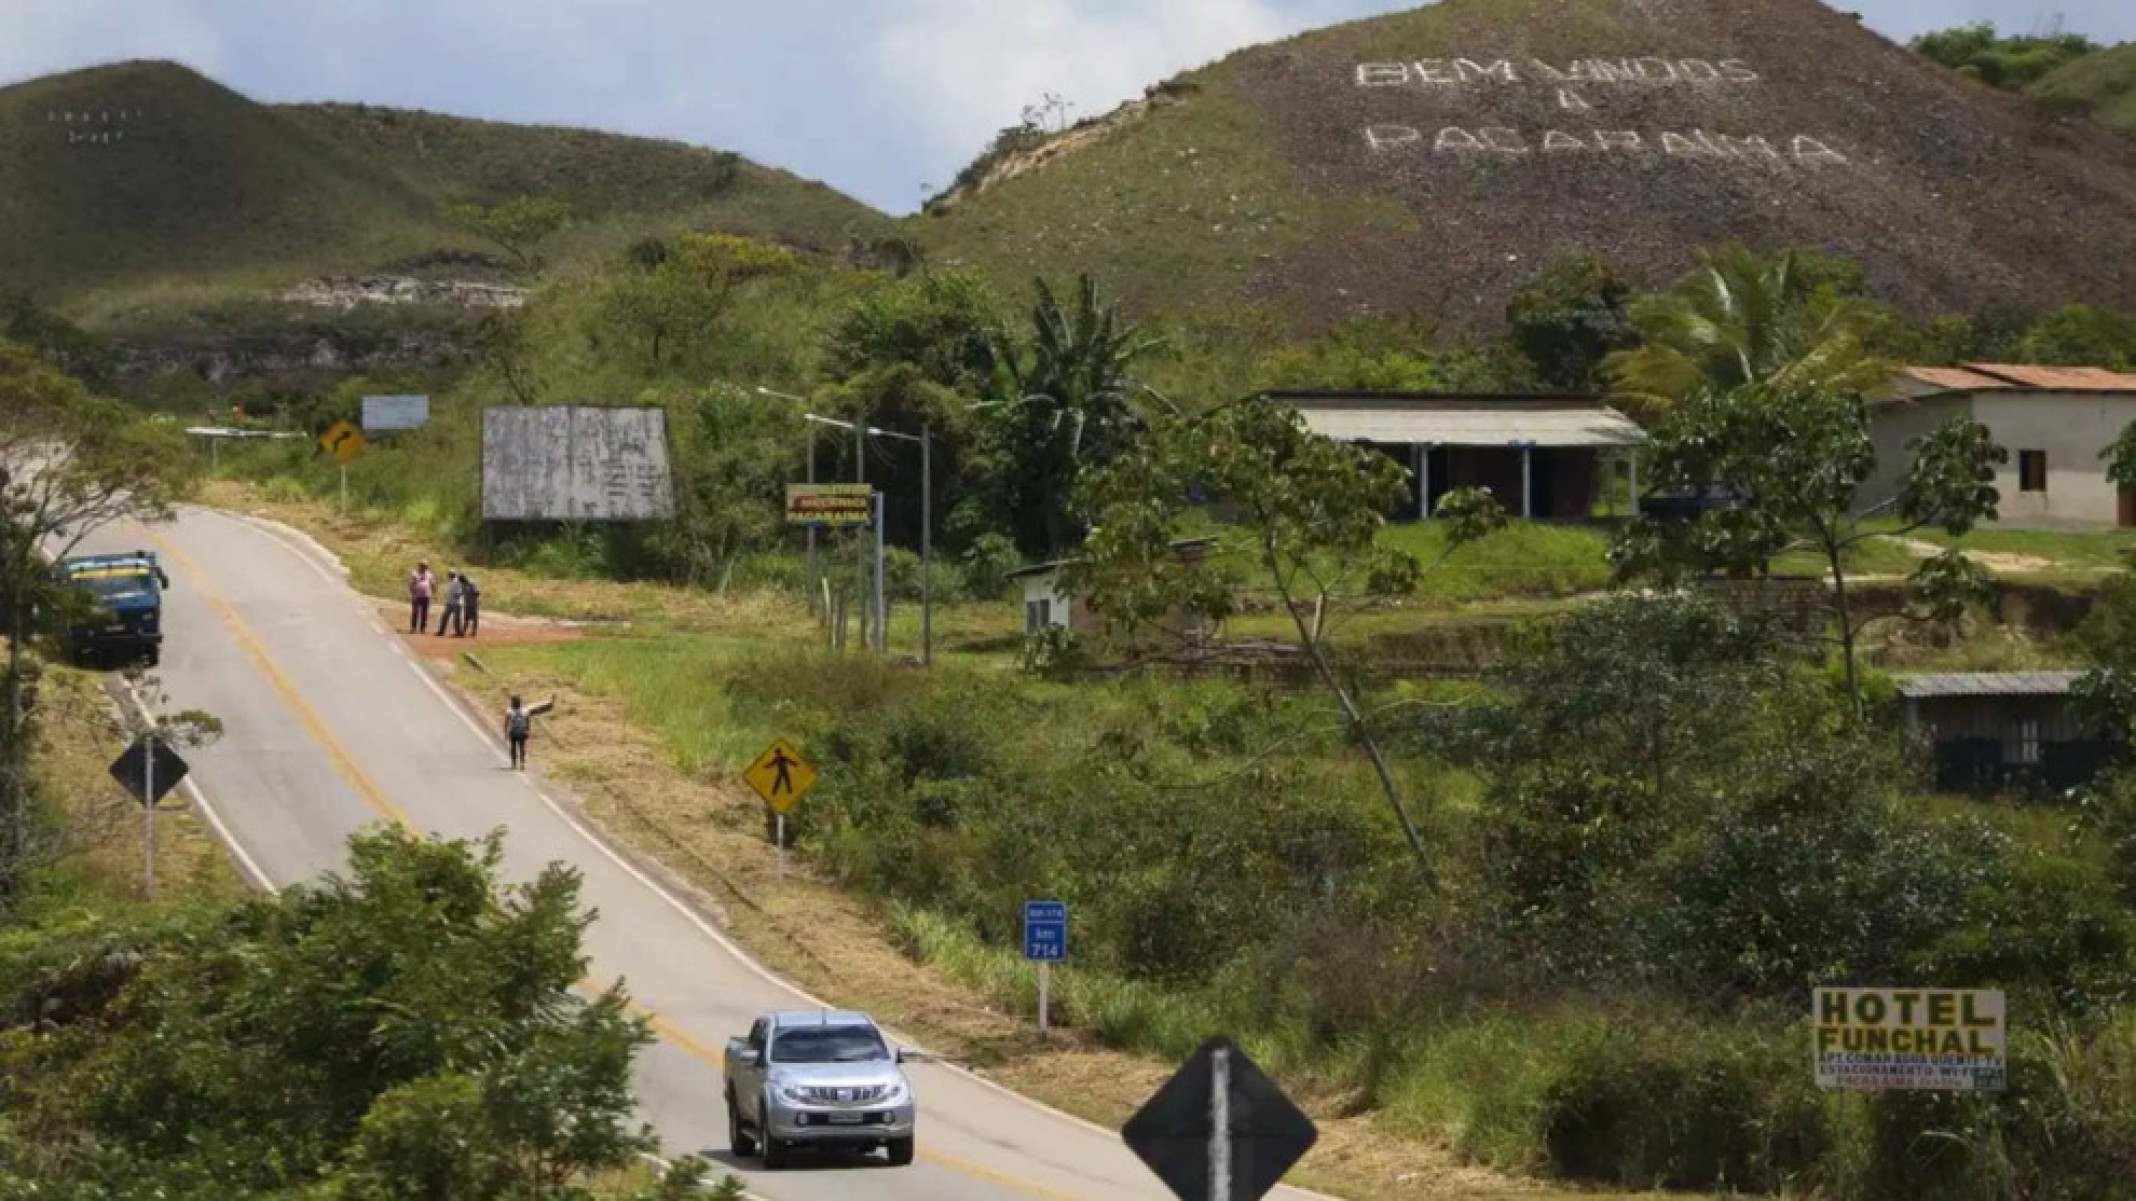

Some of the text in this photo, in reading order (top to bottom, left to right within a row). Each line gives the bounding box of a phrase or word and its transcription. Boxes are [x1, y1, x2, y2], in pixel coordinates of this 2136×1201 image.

[1357, 56, 1759, 88] BEM VINDOS
[1365, 124, 1849, 165] PACARAIMA
[1032, 943, 1058, 957] 714
[1821, 991, 1996, 1026] HOTEL
[1818, 1027, 1995, 1055] FUNCHAL
